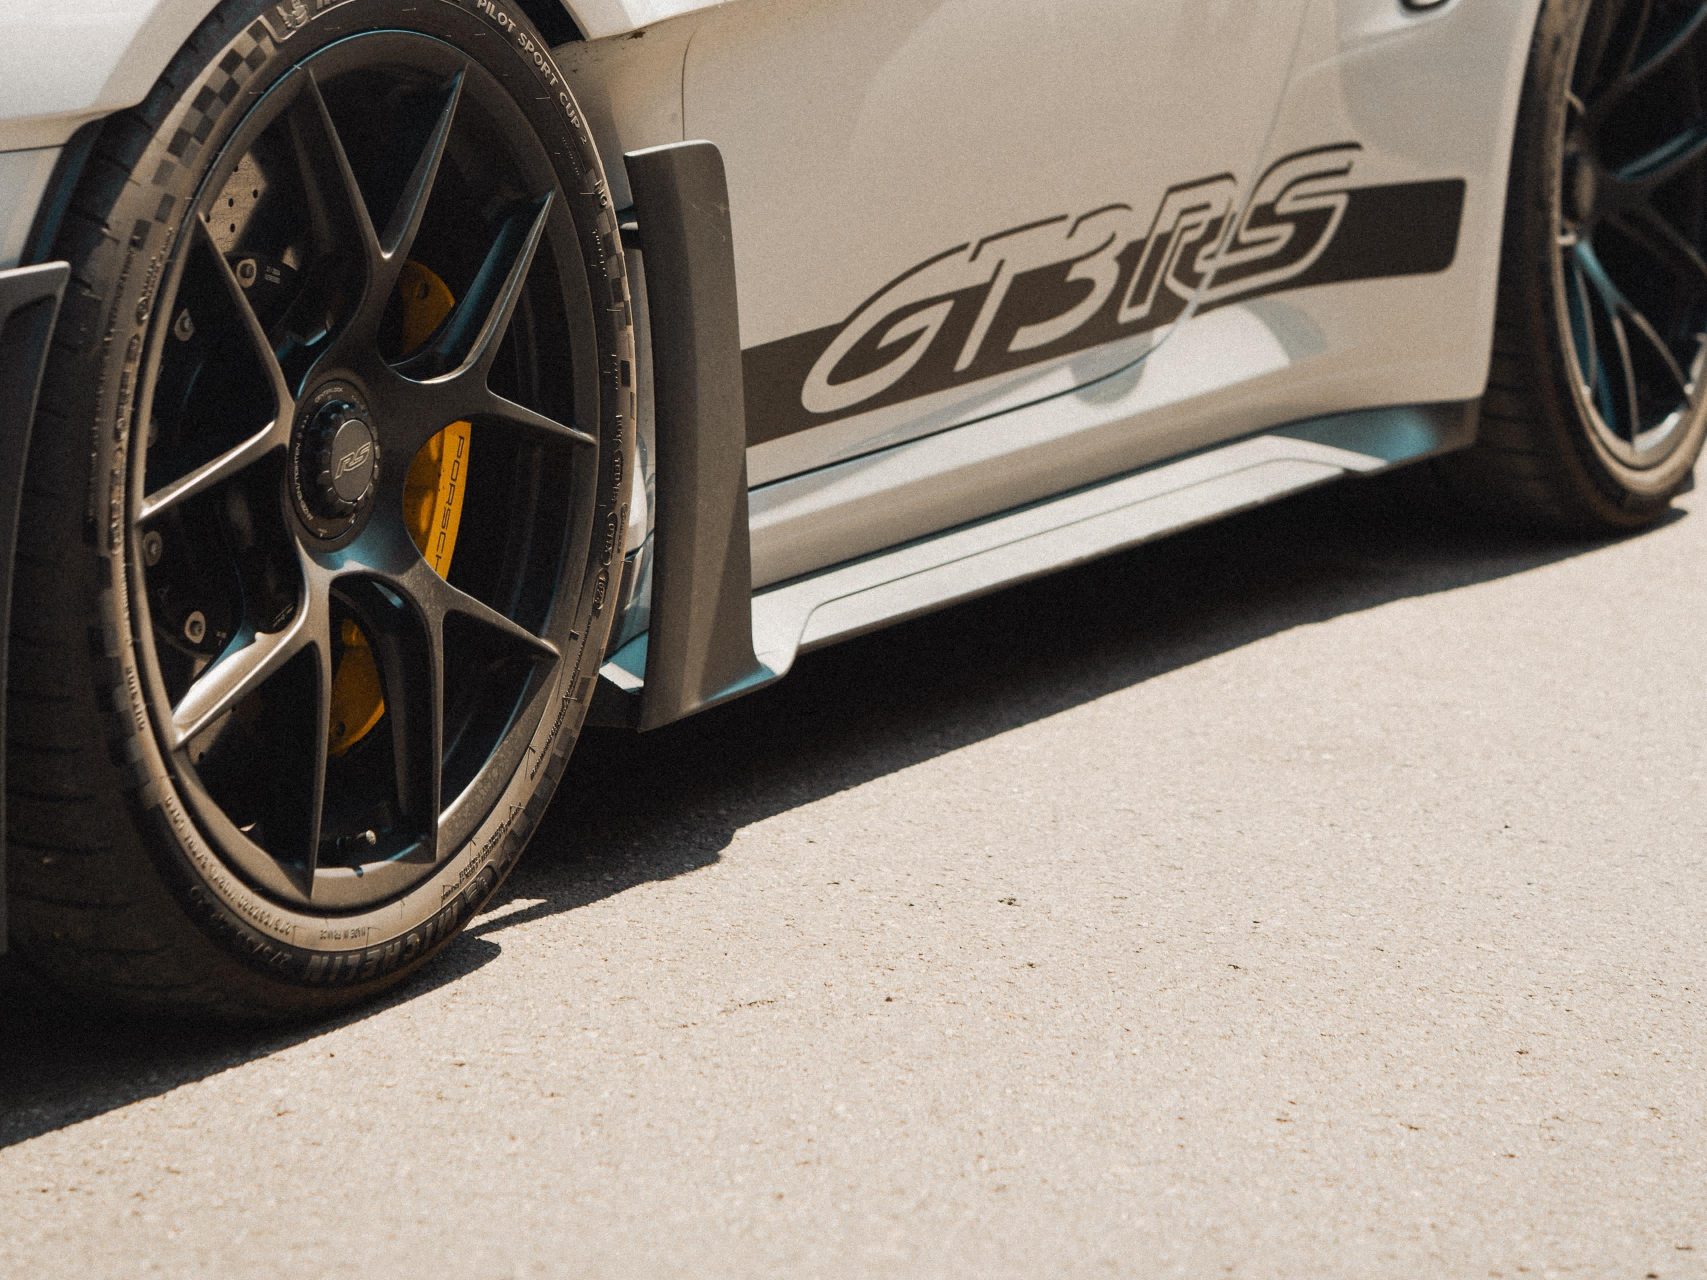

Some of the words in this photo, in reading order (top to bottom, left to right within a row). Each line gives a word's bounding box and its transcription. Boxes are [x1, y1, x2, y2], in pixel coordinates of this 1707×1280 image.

[517, 32, 559, 87] SPORT
[559, 91, 581, 129] CUP
[334, 441, 372, 480] RS
